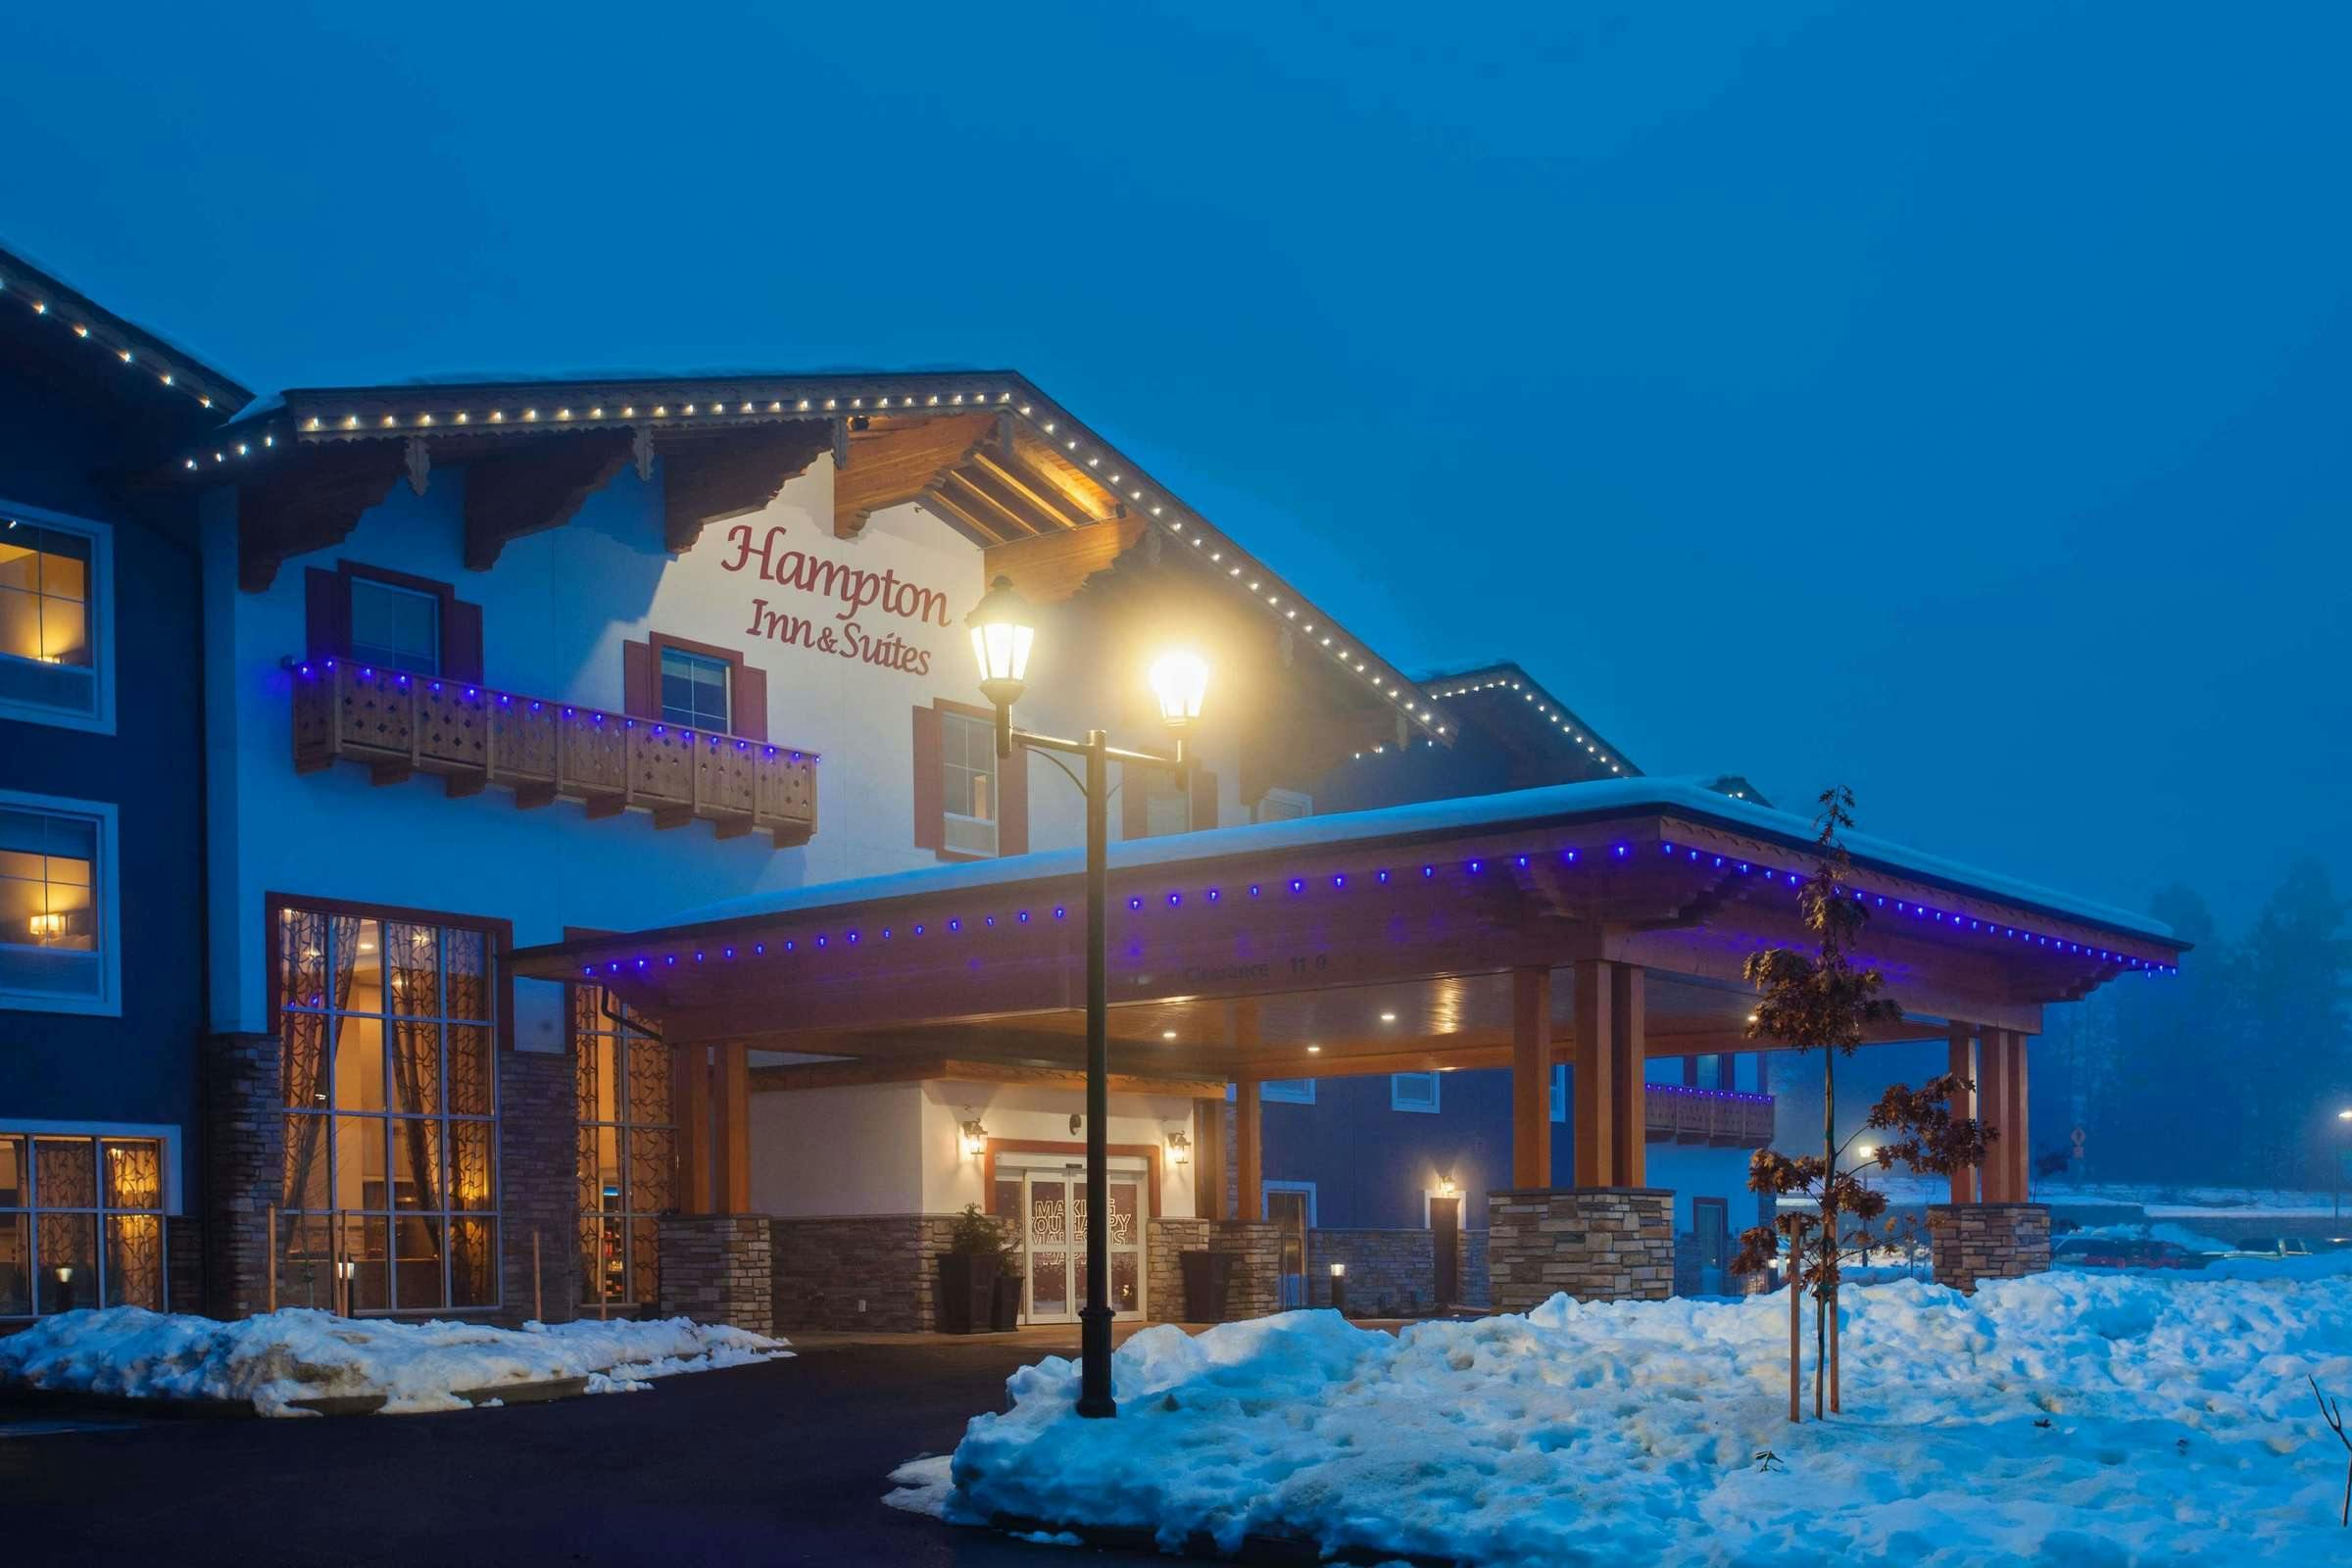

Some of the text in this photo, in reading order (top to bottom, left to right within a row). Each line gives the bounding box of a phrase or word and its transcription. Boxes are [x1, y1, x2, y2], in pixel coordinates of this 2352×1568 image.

[720, 524, 952, 627] Hampton
[746, 598, 931, 676] Inn & Suites
[1031, 1215, 1061, 1233] OU
[1035, 1199, 1116, 1217] MAKIG
